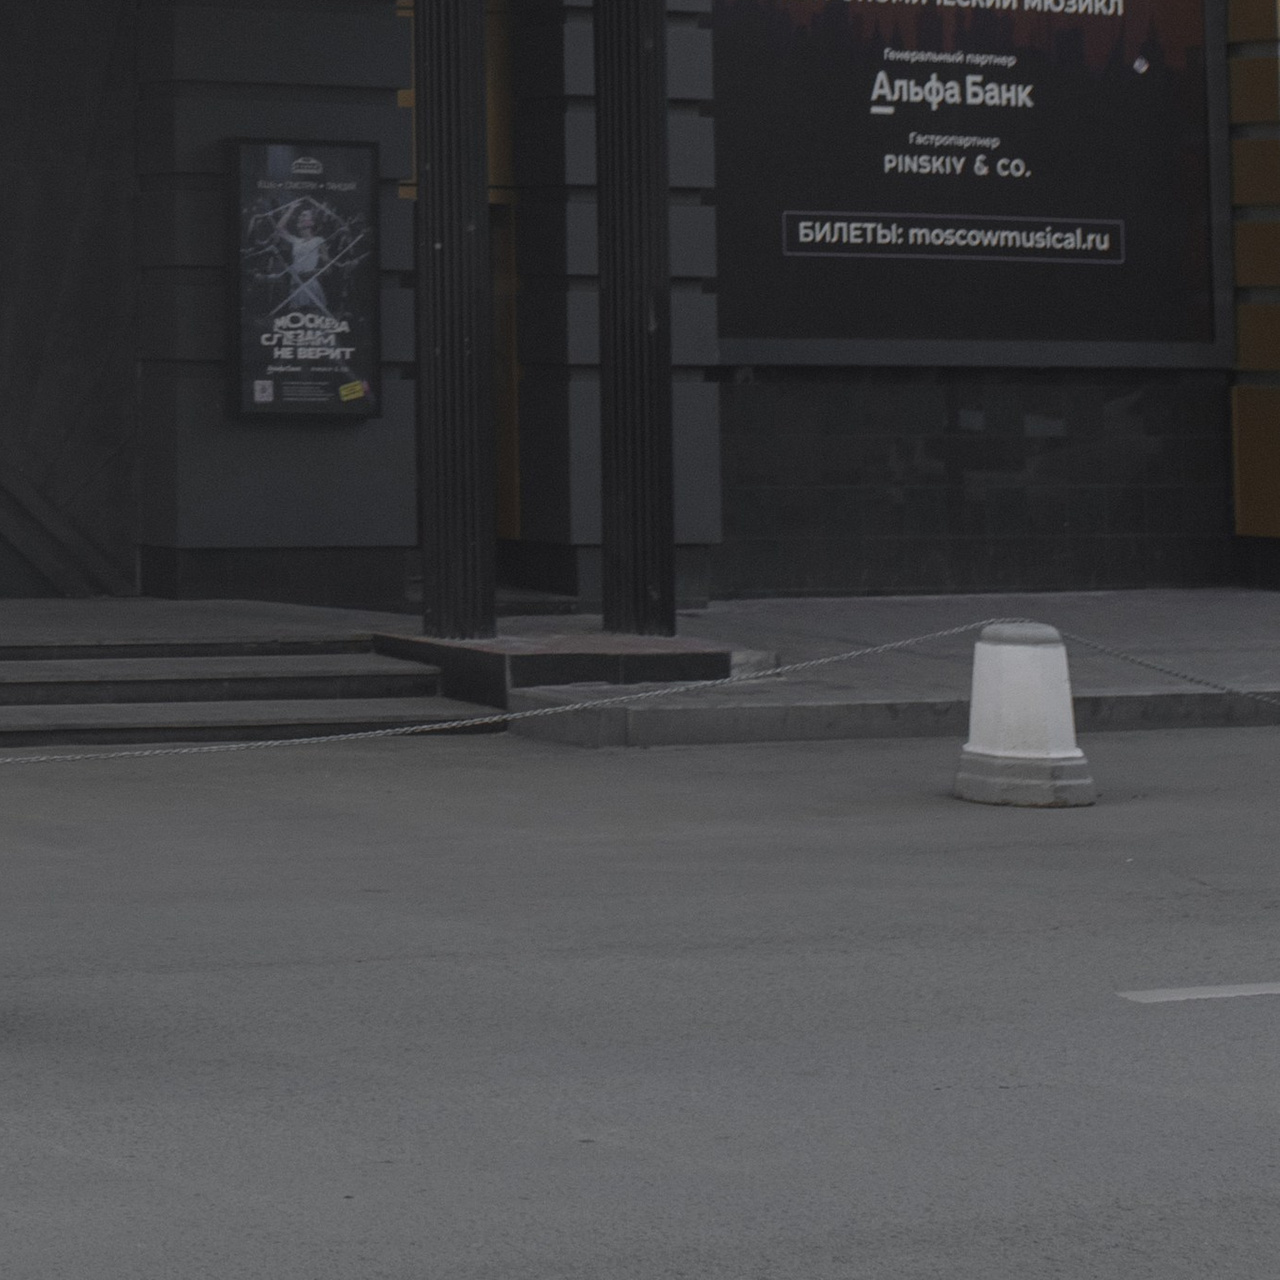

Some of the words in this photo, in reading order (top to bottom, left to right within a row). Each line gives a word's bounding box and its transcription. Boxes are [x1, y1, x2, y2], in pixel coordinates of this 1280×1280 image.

[883, 47, 964, 64] Генеральный
[870, 69, 961, 112] Альфа
[965, 74, 1035, 108] Банк
[883, 154, 966, 175] PINSKIY
[973, 154, 990, 176] &
[798, 220, 904, 245] БИЛЕТЫ:
[908, 224, 1110, 251] moscowmusical.ru
